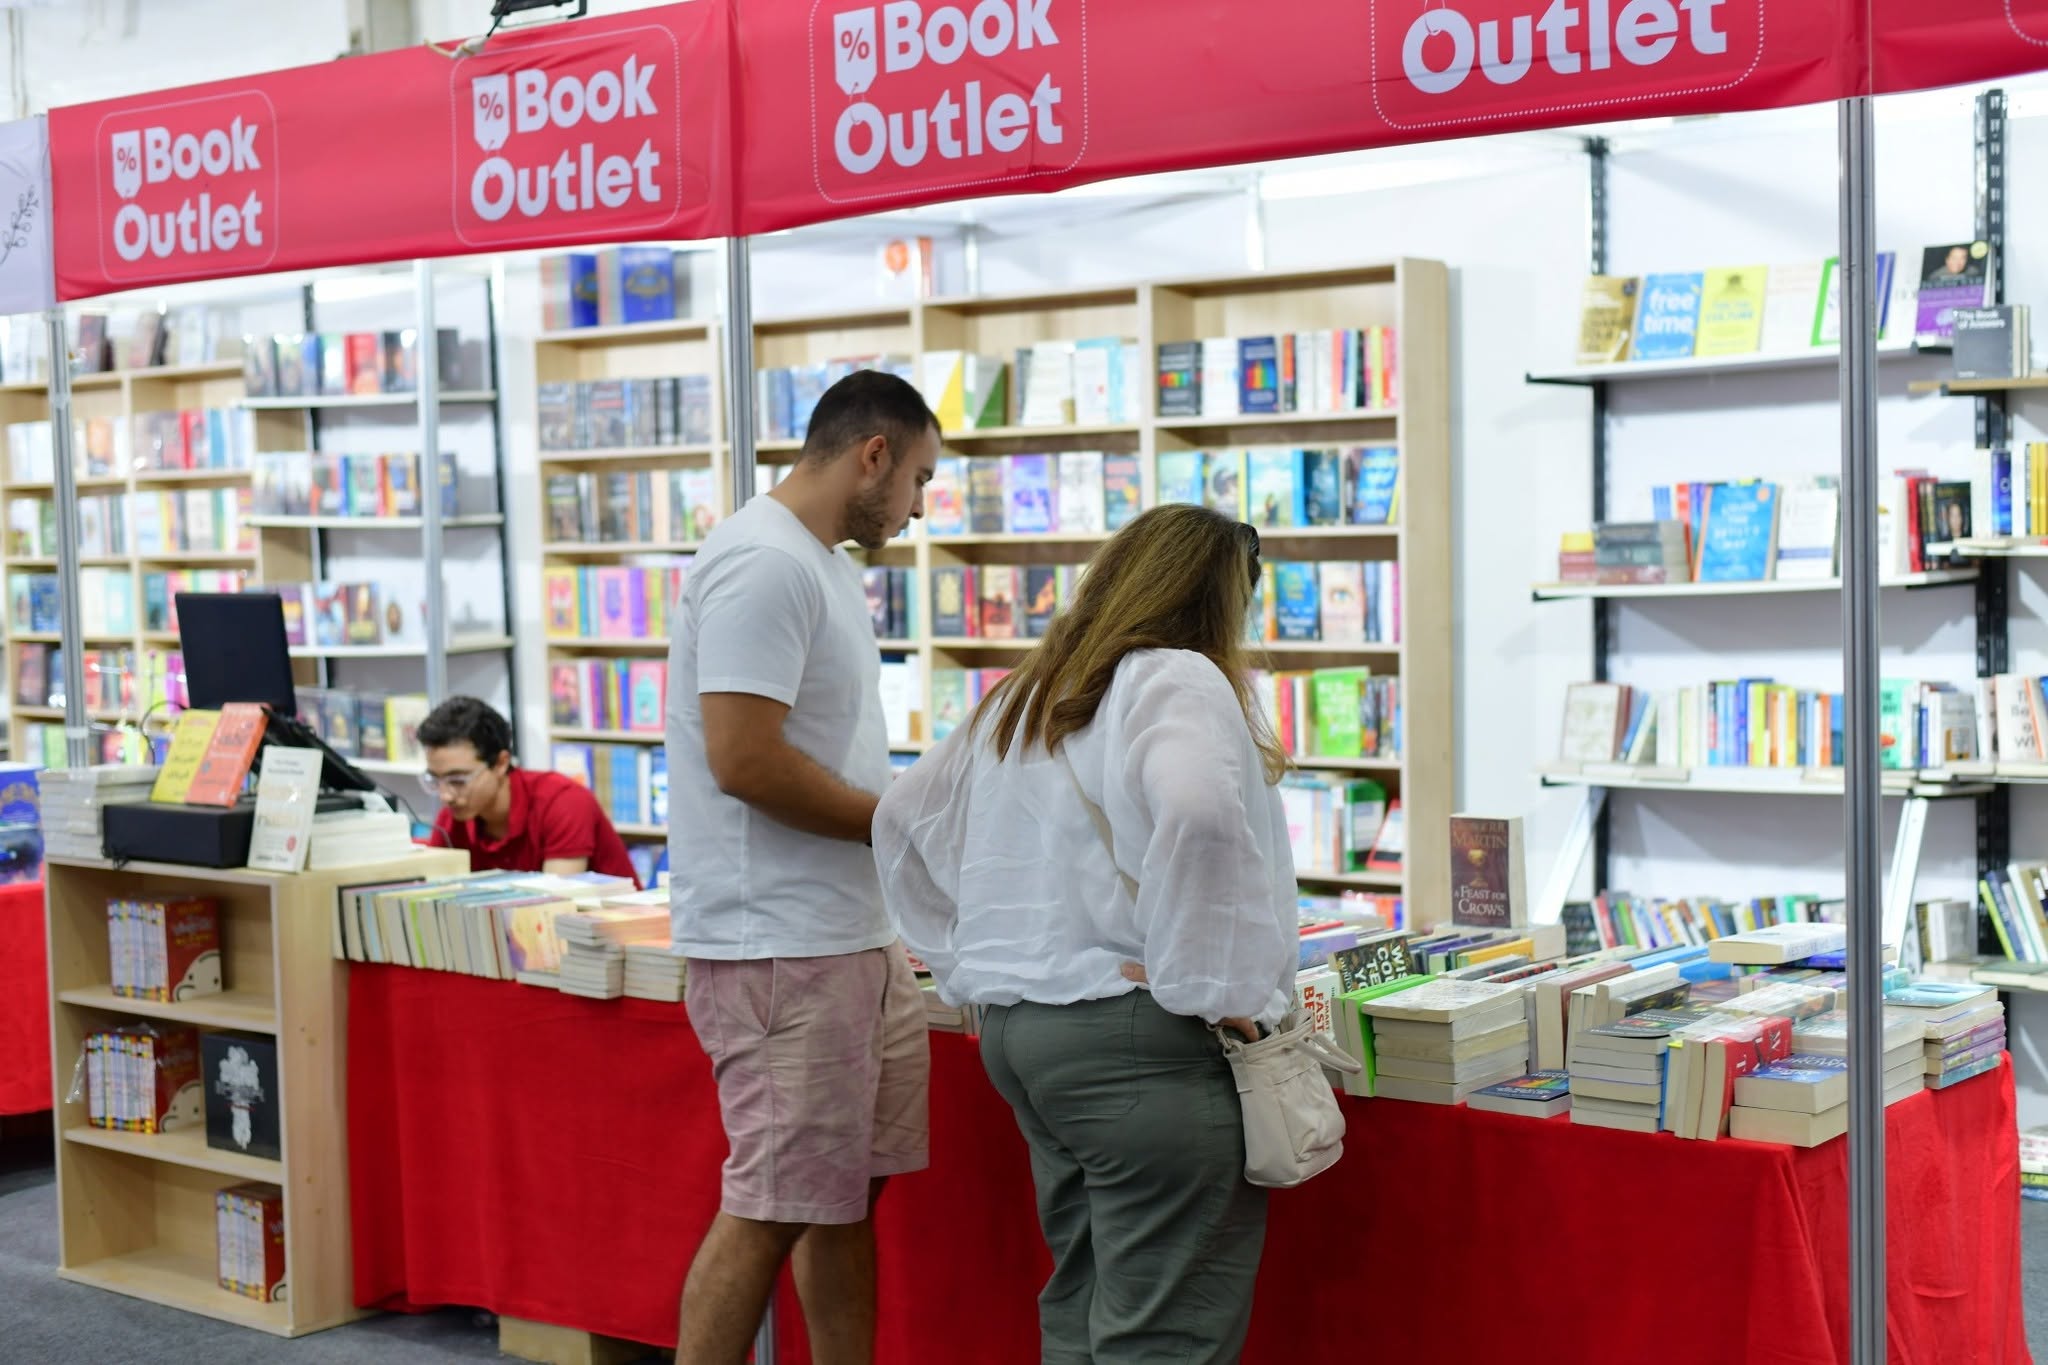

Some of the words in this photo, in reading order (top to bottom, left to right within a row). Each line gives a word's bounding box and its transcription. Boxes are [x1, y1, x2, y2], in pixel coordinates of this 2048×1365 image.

[883, 0, 1060, 73] Book
[1402, 0, 1727, 94] Outlet
[515, 53, 659, 133] Book
[834, 72, 1063, 174] Outlet
[144, 115, 261, 184] Book
[471, 138, 661, 221] Outlet
[113, 189, 263, 262] Outlet
[1649, 288, 1697, 315] free
[1976, 310, 1999, 319] Book
[1642, 311, 1694, 335] time
[1452, 831, 1507, 849] MARTIN
[1458, 898, 1505, 917] CROWS
[1461, 885, 1490, 900] FEAST
[1491, 891, 1507, 900] FOR
[1354, 967, 1369, 990] YO
[1366, 958, 1381, 986] TE
[1391, 945, 1408, 980] WIS
[1316, 993, 1325, 1031] FAST
